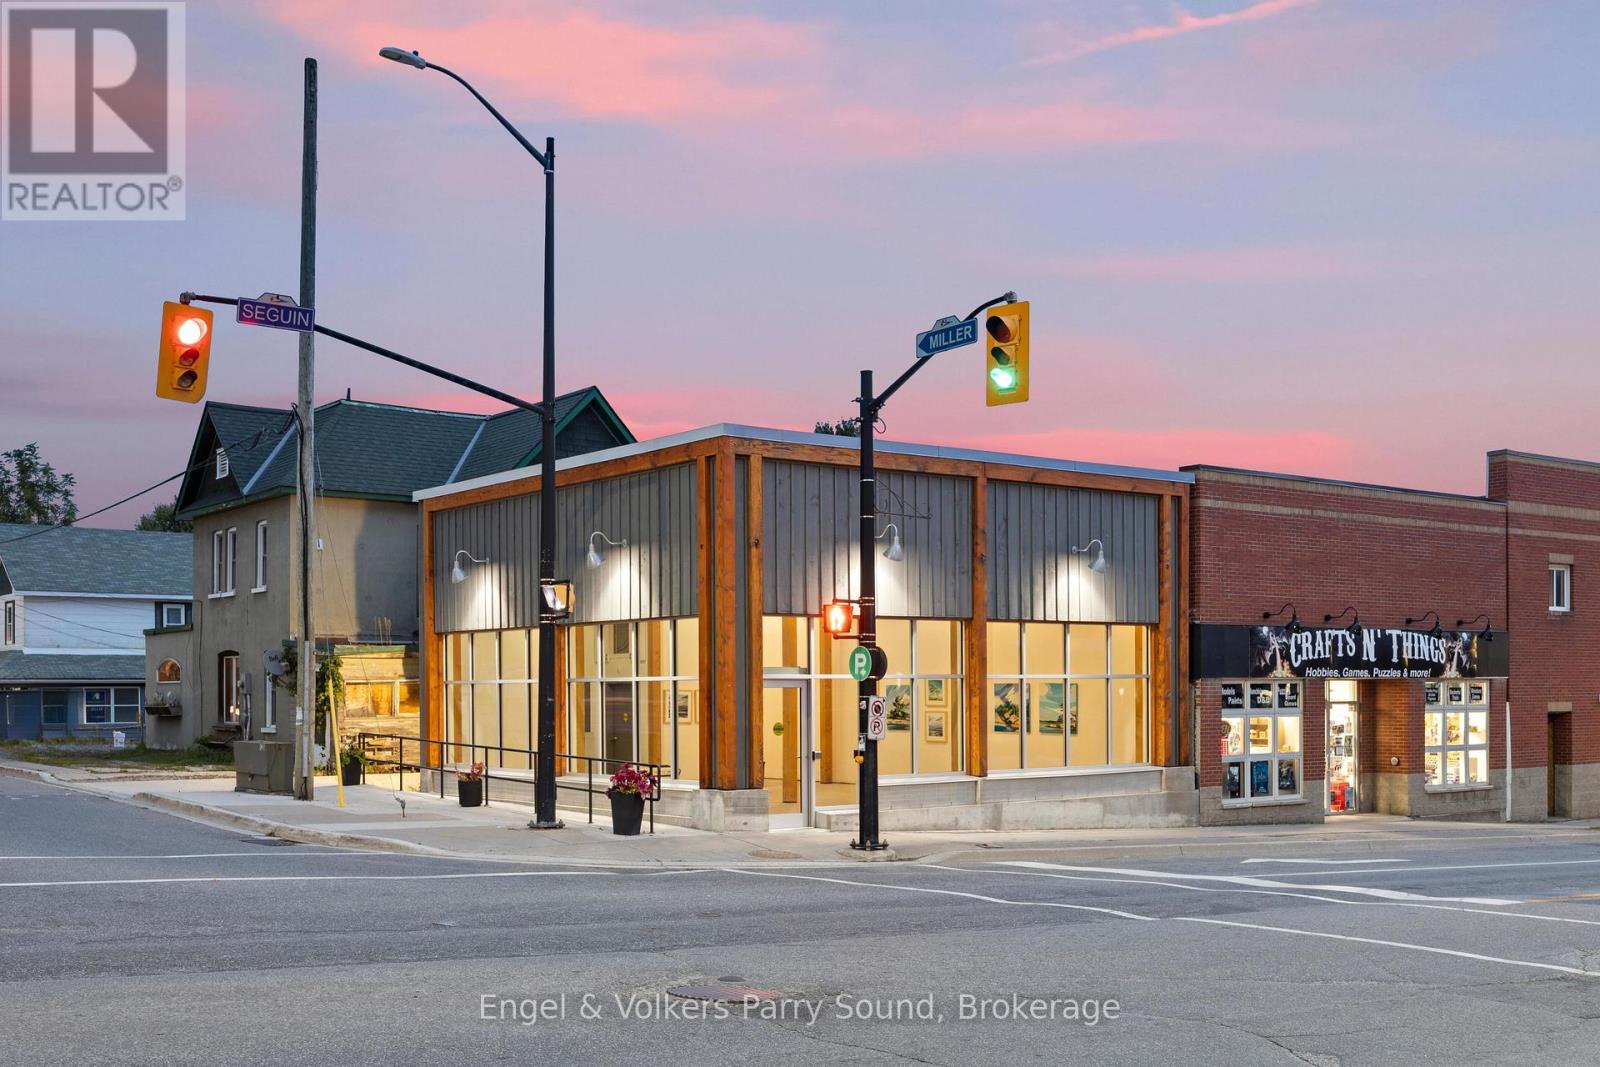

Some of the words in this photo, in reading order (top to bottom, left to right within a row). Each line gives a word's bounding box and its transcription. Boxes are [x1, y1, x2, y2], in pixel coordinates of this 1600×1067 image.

[242, 303, 309, 327] SEGUIN
[929, 325, 973, 350] MILLER
[1290, 629, 1356, 668] CRAFTS
[1385, 629, 1446, 664] THINGS
[854, 653, 867, 675] P
[1305, 667, 1341, 678] Hobbies,
[1342, 667, 1371, 678] Games,
[1373, 667, 1401, 677] Puzzles
[1402, 668, 1408, 677] &
[1409, 668, 1432, 678] more!
